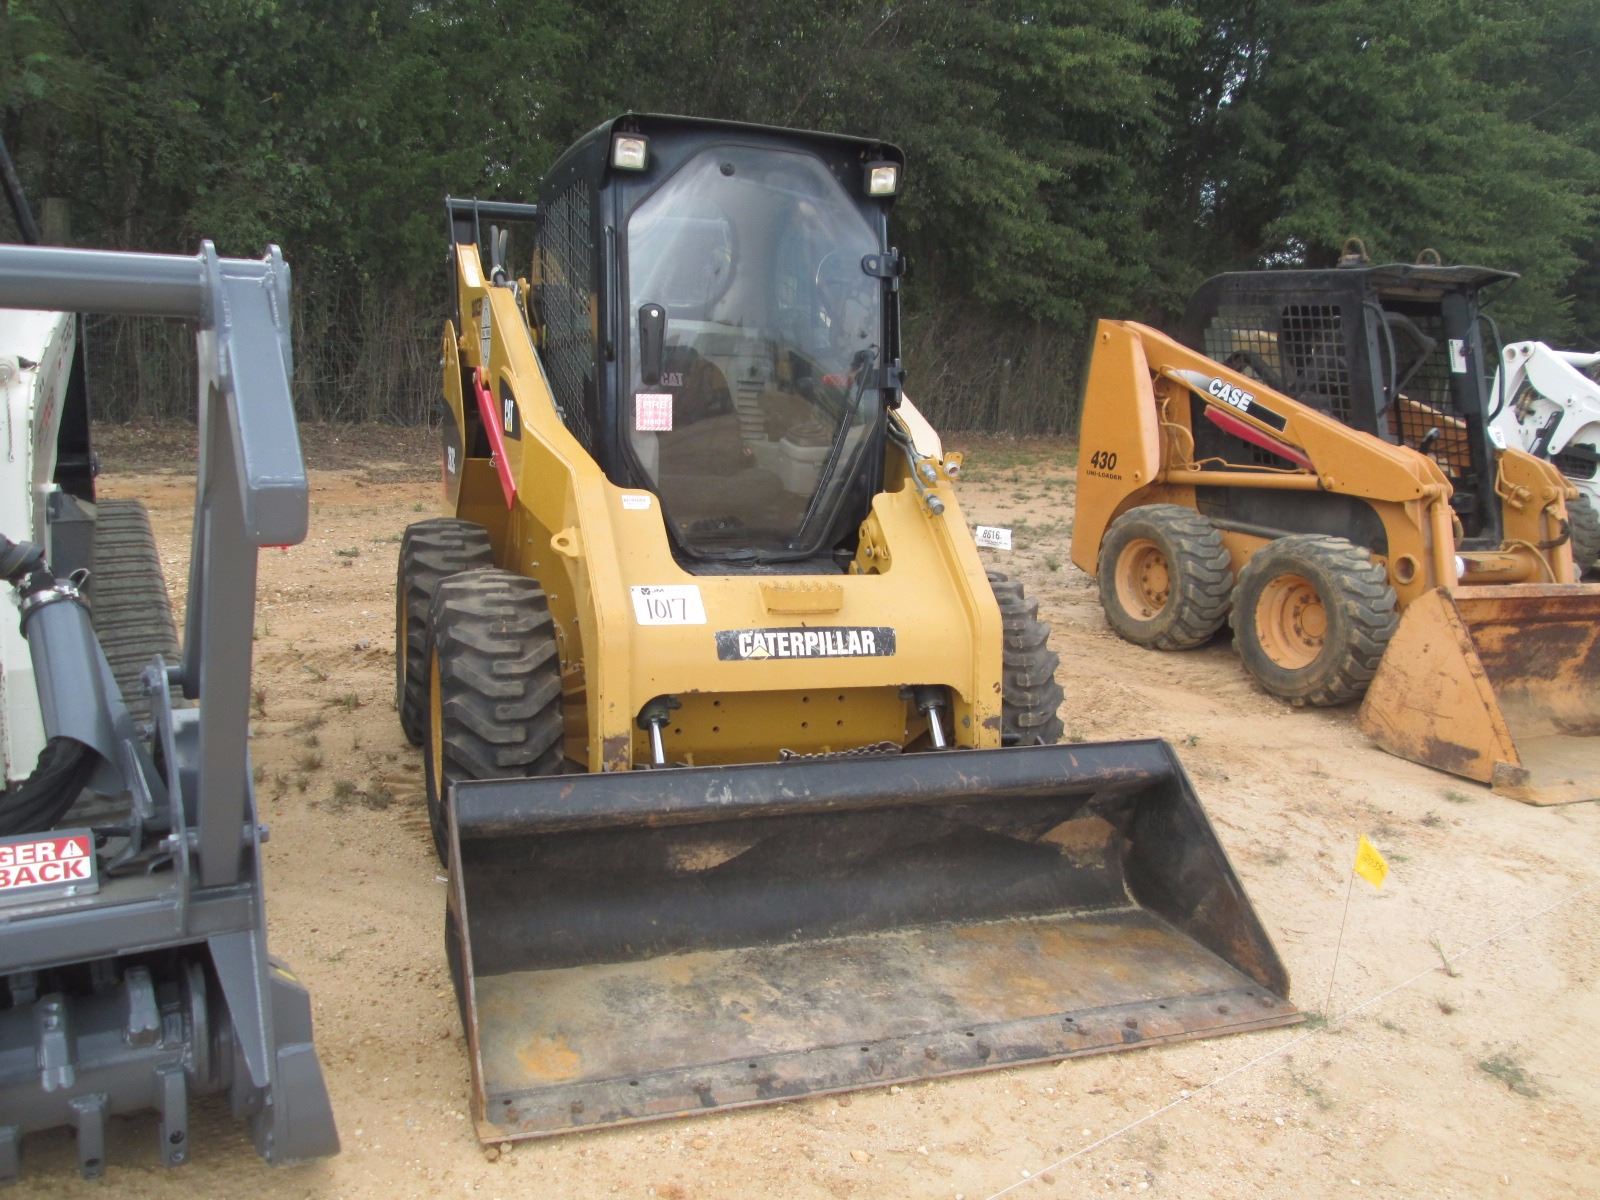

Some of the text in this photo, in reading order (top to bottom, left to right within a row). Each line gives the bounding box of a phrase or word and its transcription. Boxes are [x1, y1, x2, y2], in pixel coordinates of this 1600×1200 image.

[660, 372, 684, 386] CAT
[1209, 377, 1254, 412] CASE
[1091, 450, 1117, 470] 430
[1086, 470, 1122, 480] UNI-LOADER
[647, 598, 686, 620] 1017
[738, 630, 876, 658] CATERPILLAR
